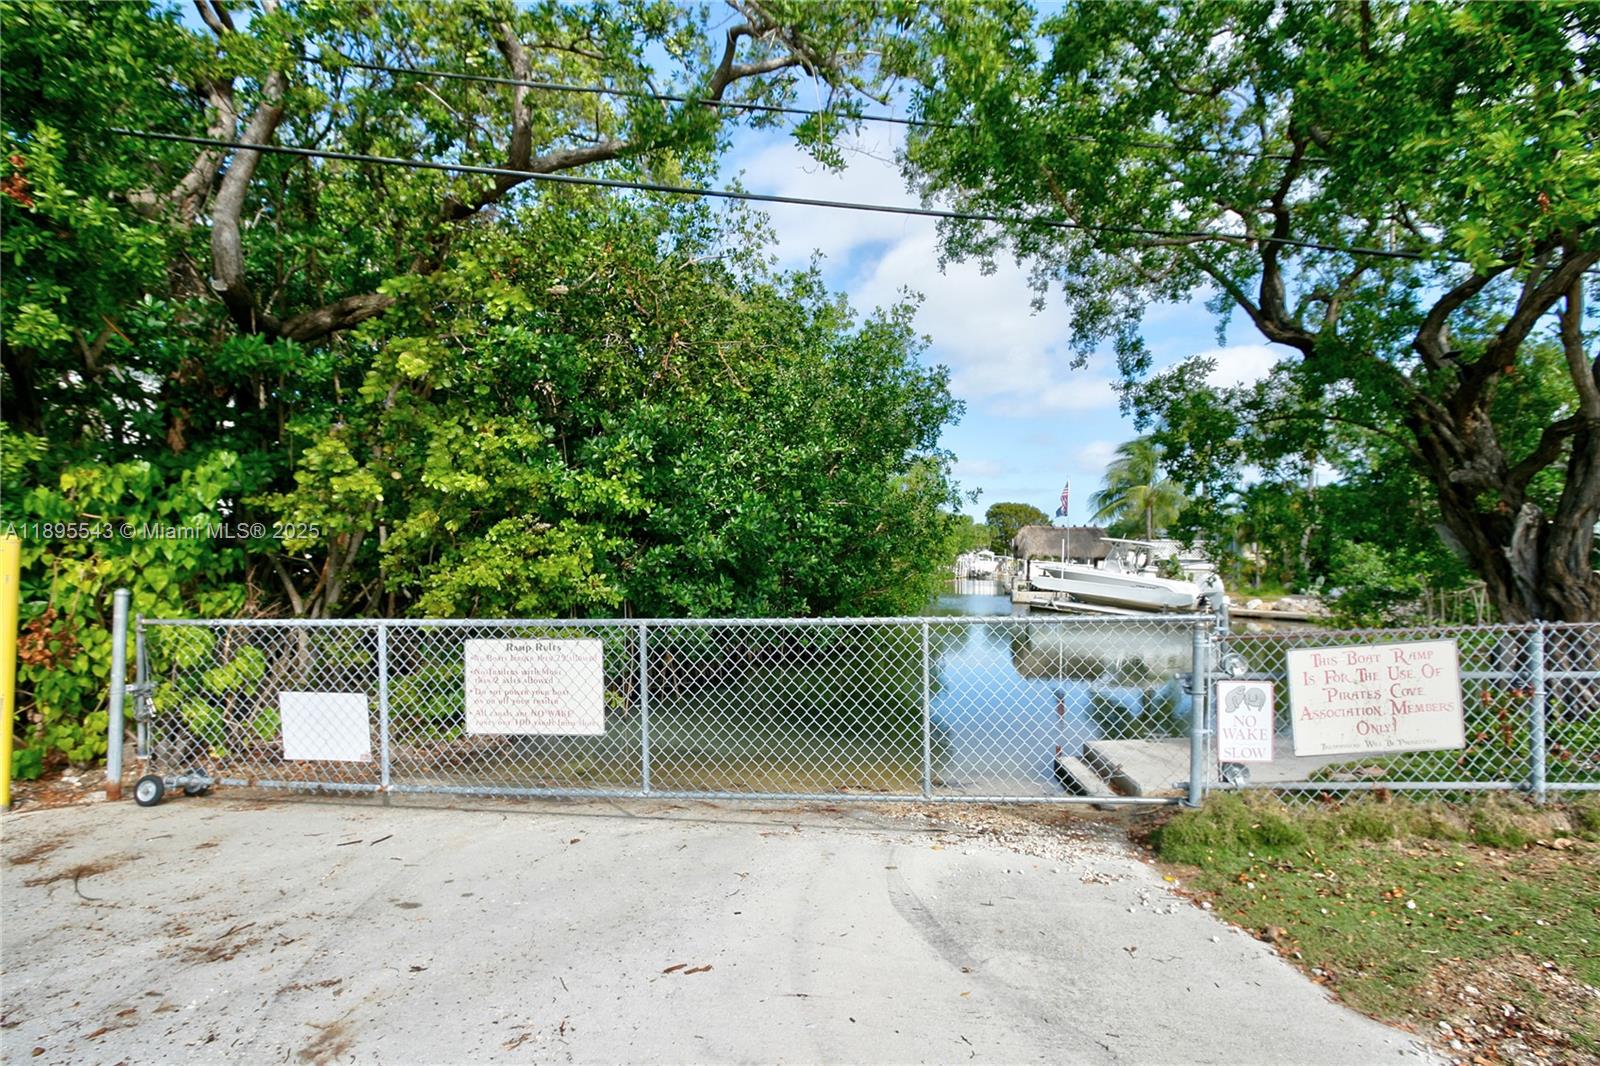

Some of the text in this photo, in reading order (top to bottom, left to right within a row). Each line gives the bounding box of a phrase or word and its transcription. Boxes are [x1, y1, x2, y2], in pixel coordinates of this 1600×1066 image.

[506, 642, 532, 653] Ramp
[1233, 715, 1257, 728] NO
[1222, 727, 1268, 741] WAKE
[1223, 747, 1266, 759] SLOW
